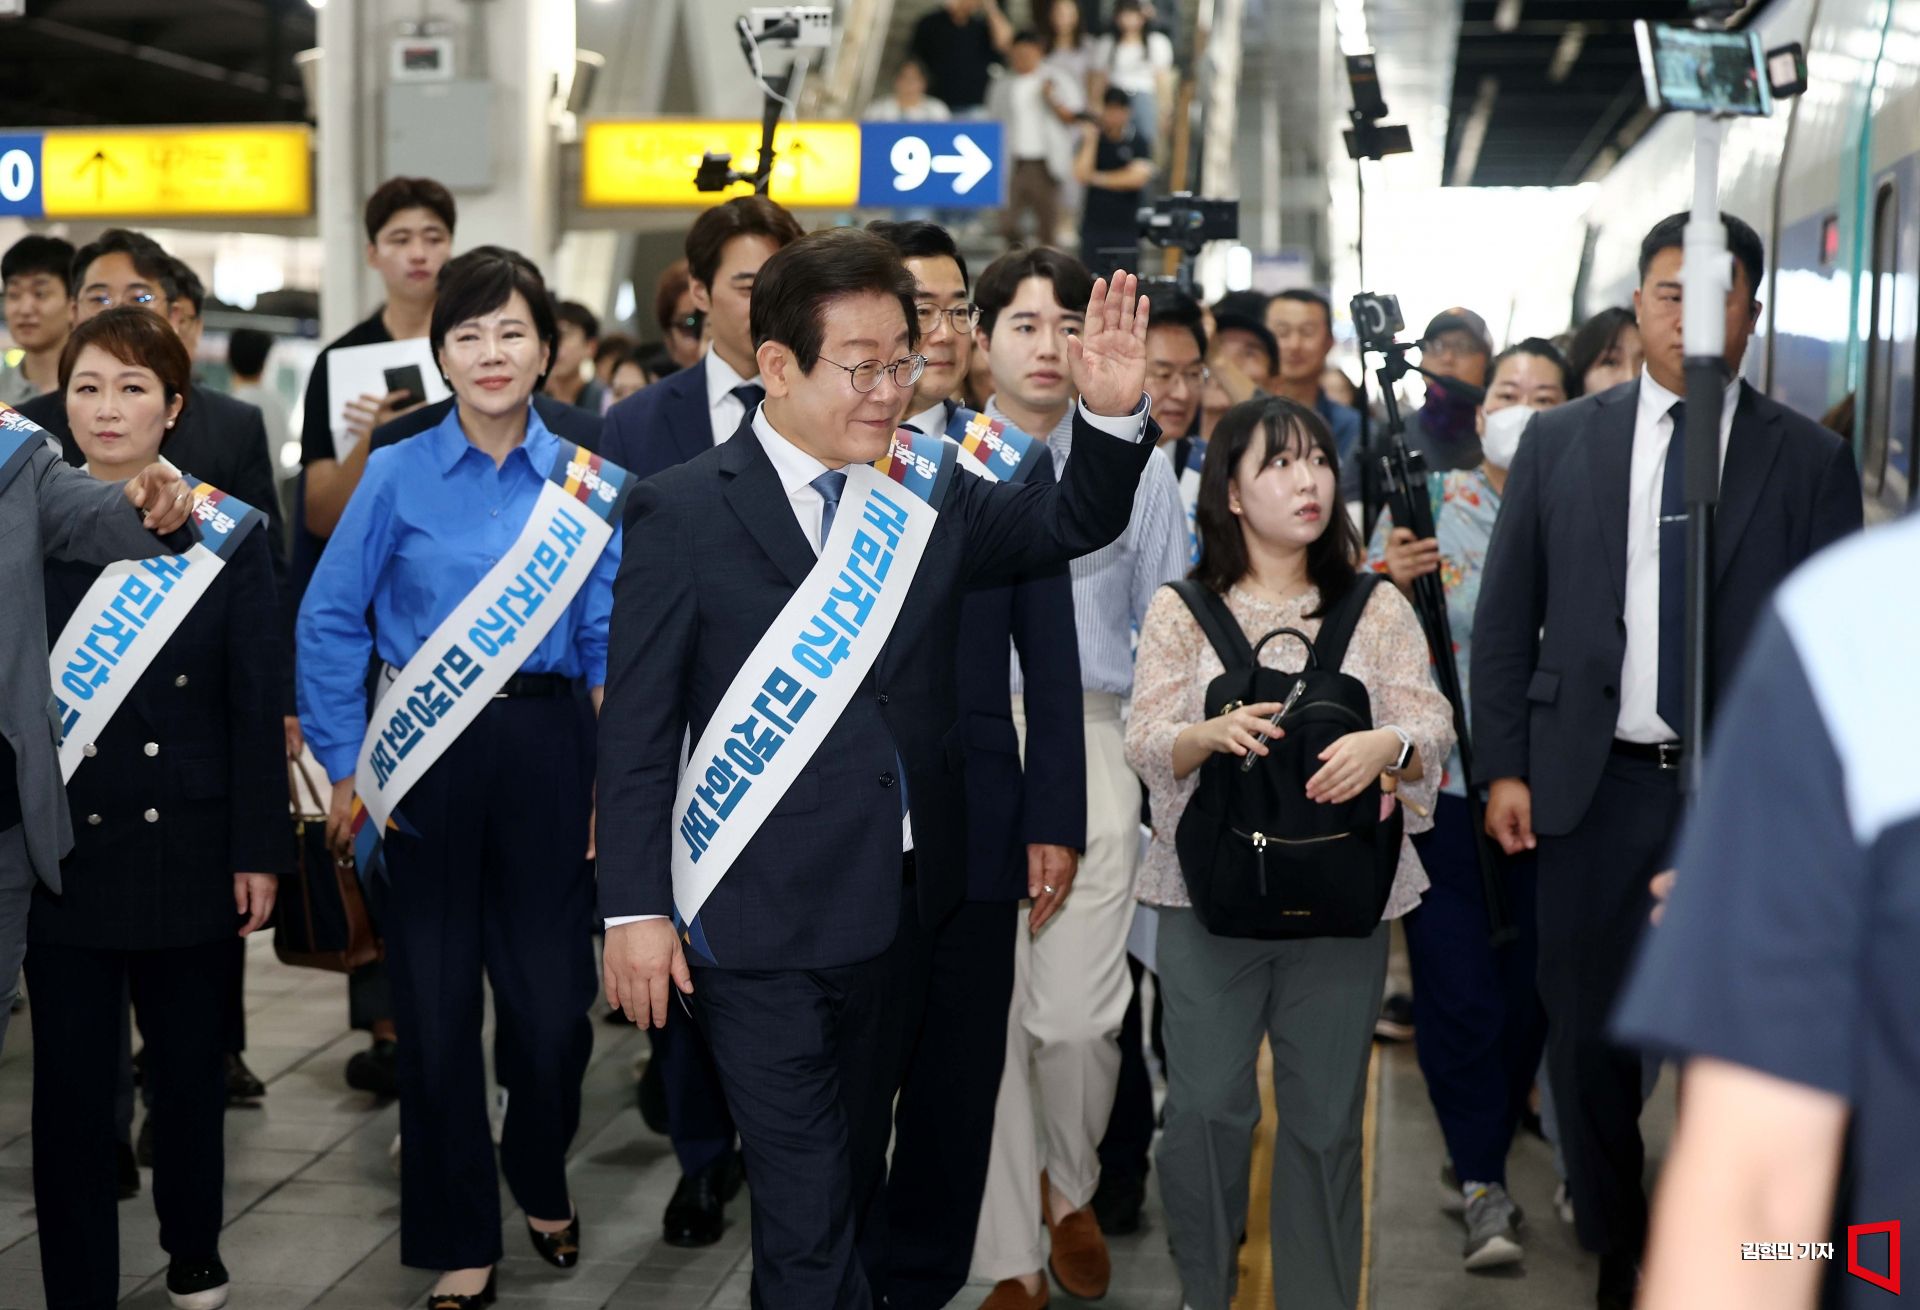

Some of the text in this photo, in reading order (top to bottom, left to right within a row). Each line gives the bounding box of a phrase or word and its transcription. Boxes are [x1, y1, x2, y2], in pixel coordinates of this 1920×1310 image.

[889, 135, 932, 192] 9
[370, 508, 586, 790] 국민건강 민생회복
[680, 489, 909, 864] 국민건강 민생회복
